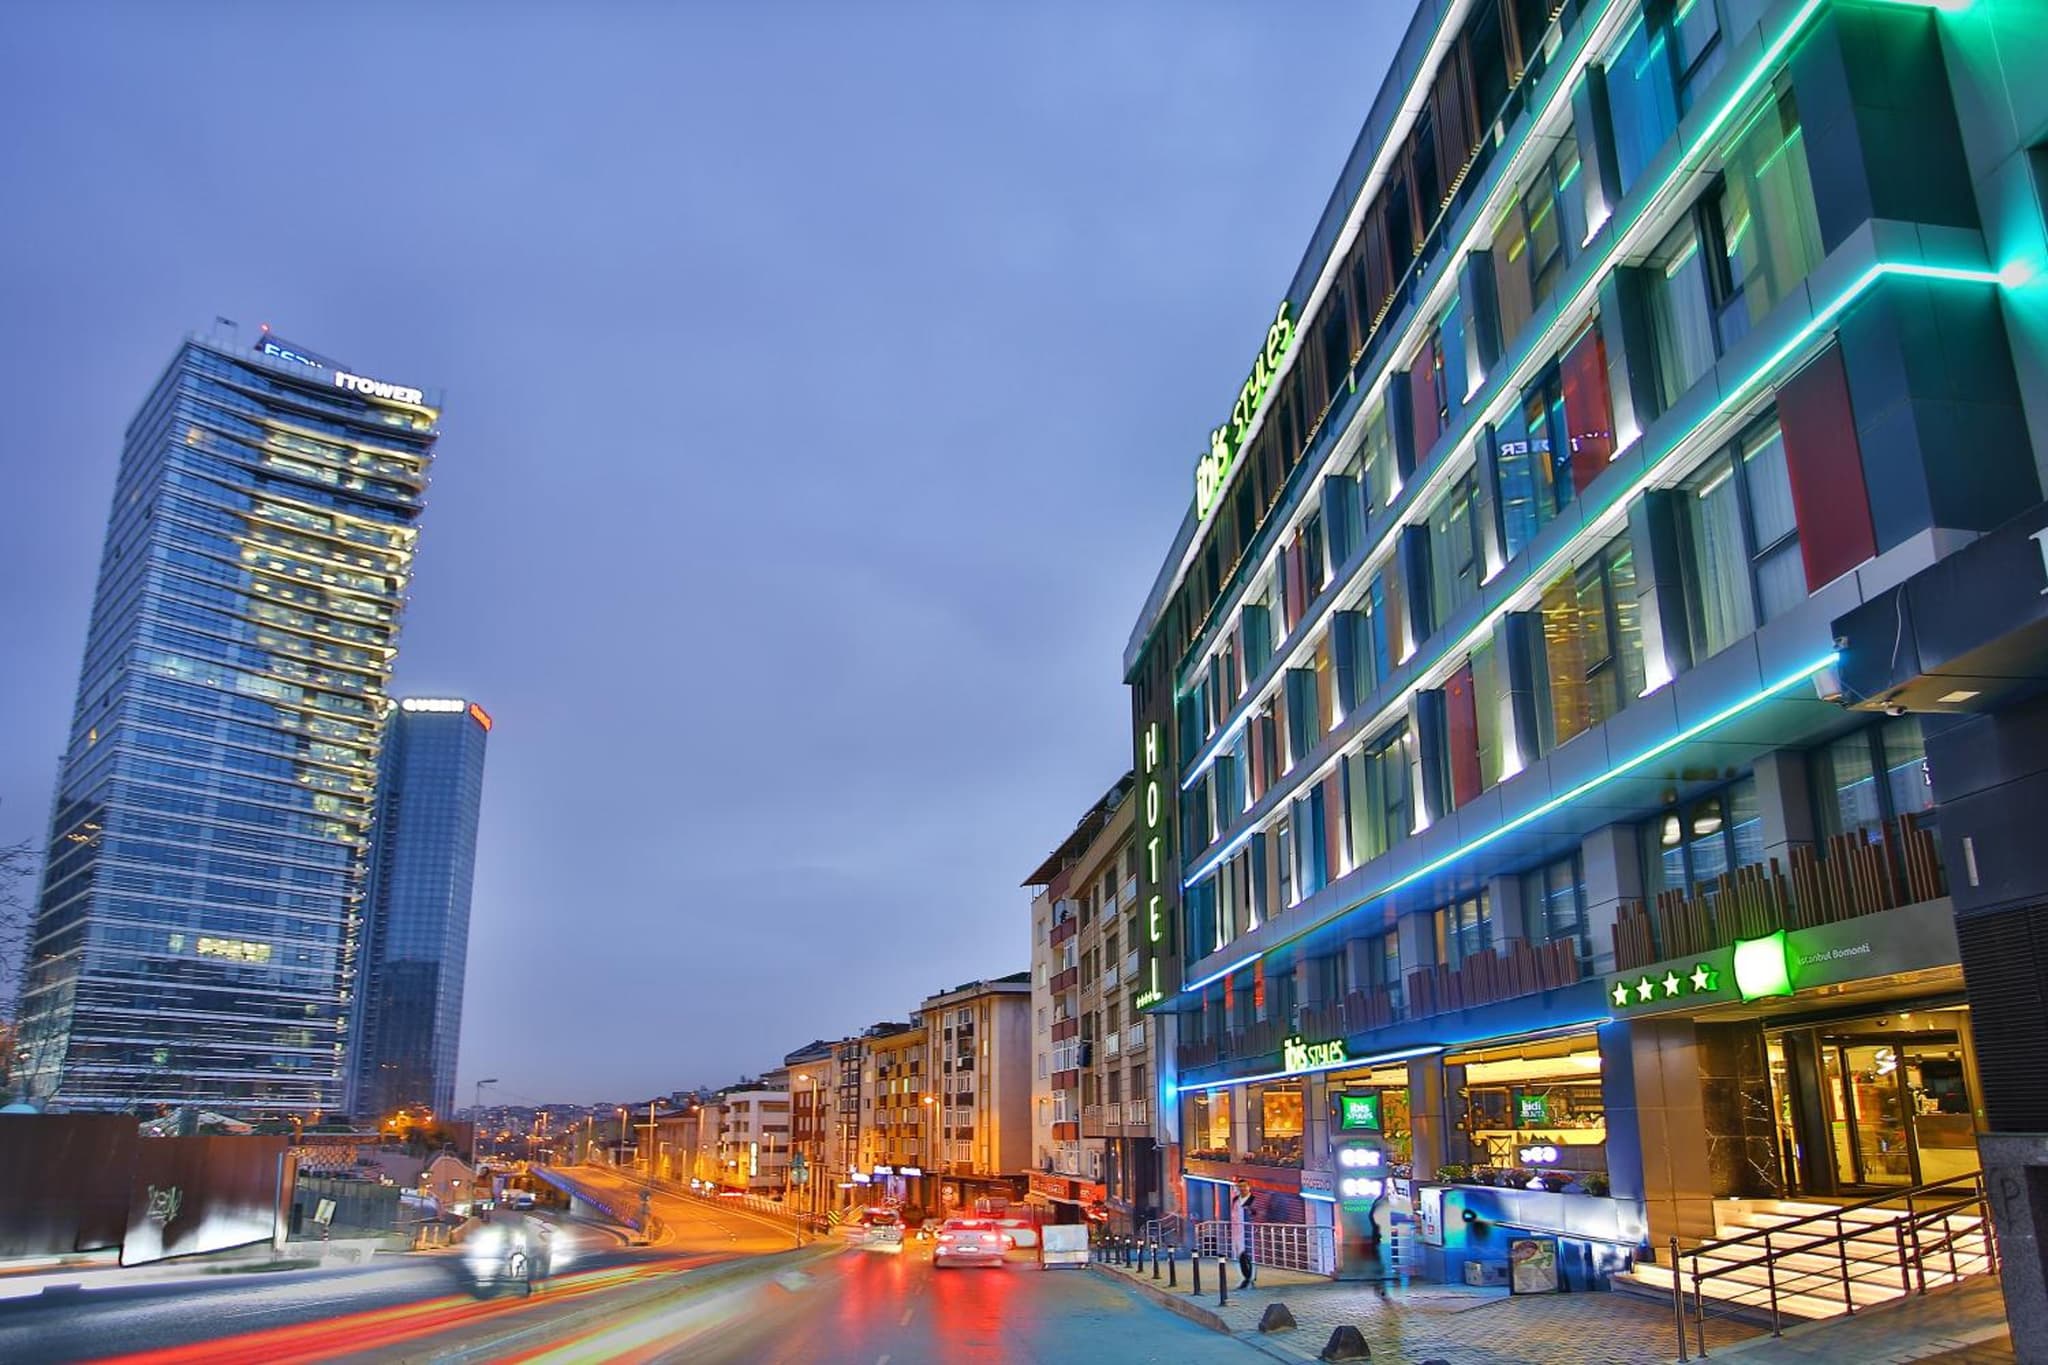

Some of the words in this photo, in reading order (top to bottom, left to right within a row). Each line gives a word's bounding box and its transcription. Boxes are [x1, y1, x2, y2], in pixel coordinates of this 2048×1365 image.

[1197, 424, 1229, 520] ibis
[1145, 722, 1161, 1000] HOTEL
[1832, 942, 1871, 959] Bomonti
[1284, 1037, 1307, 1072] ibis
